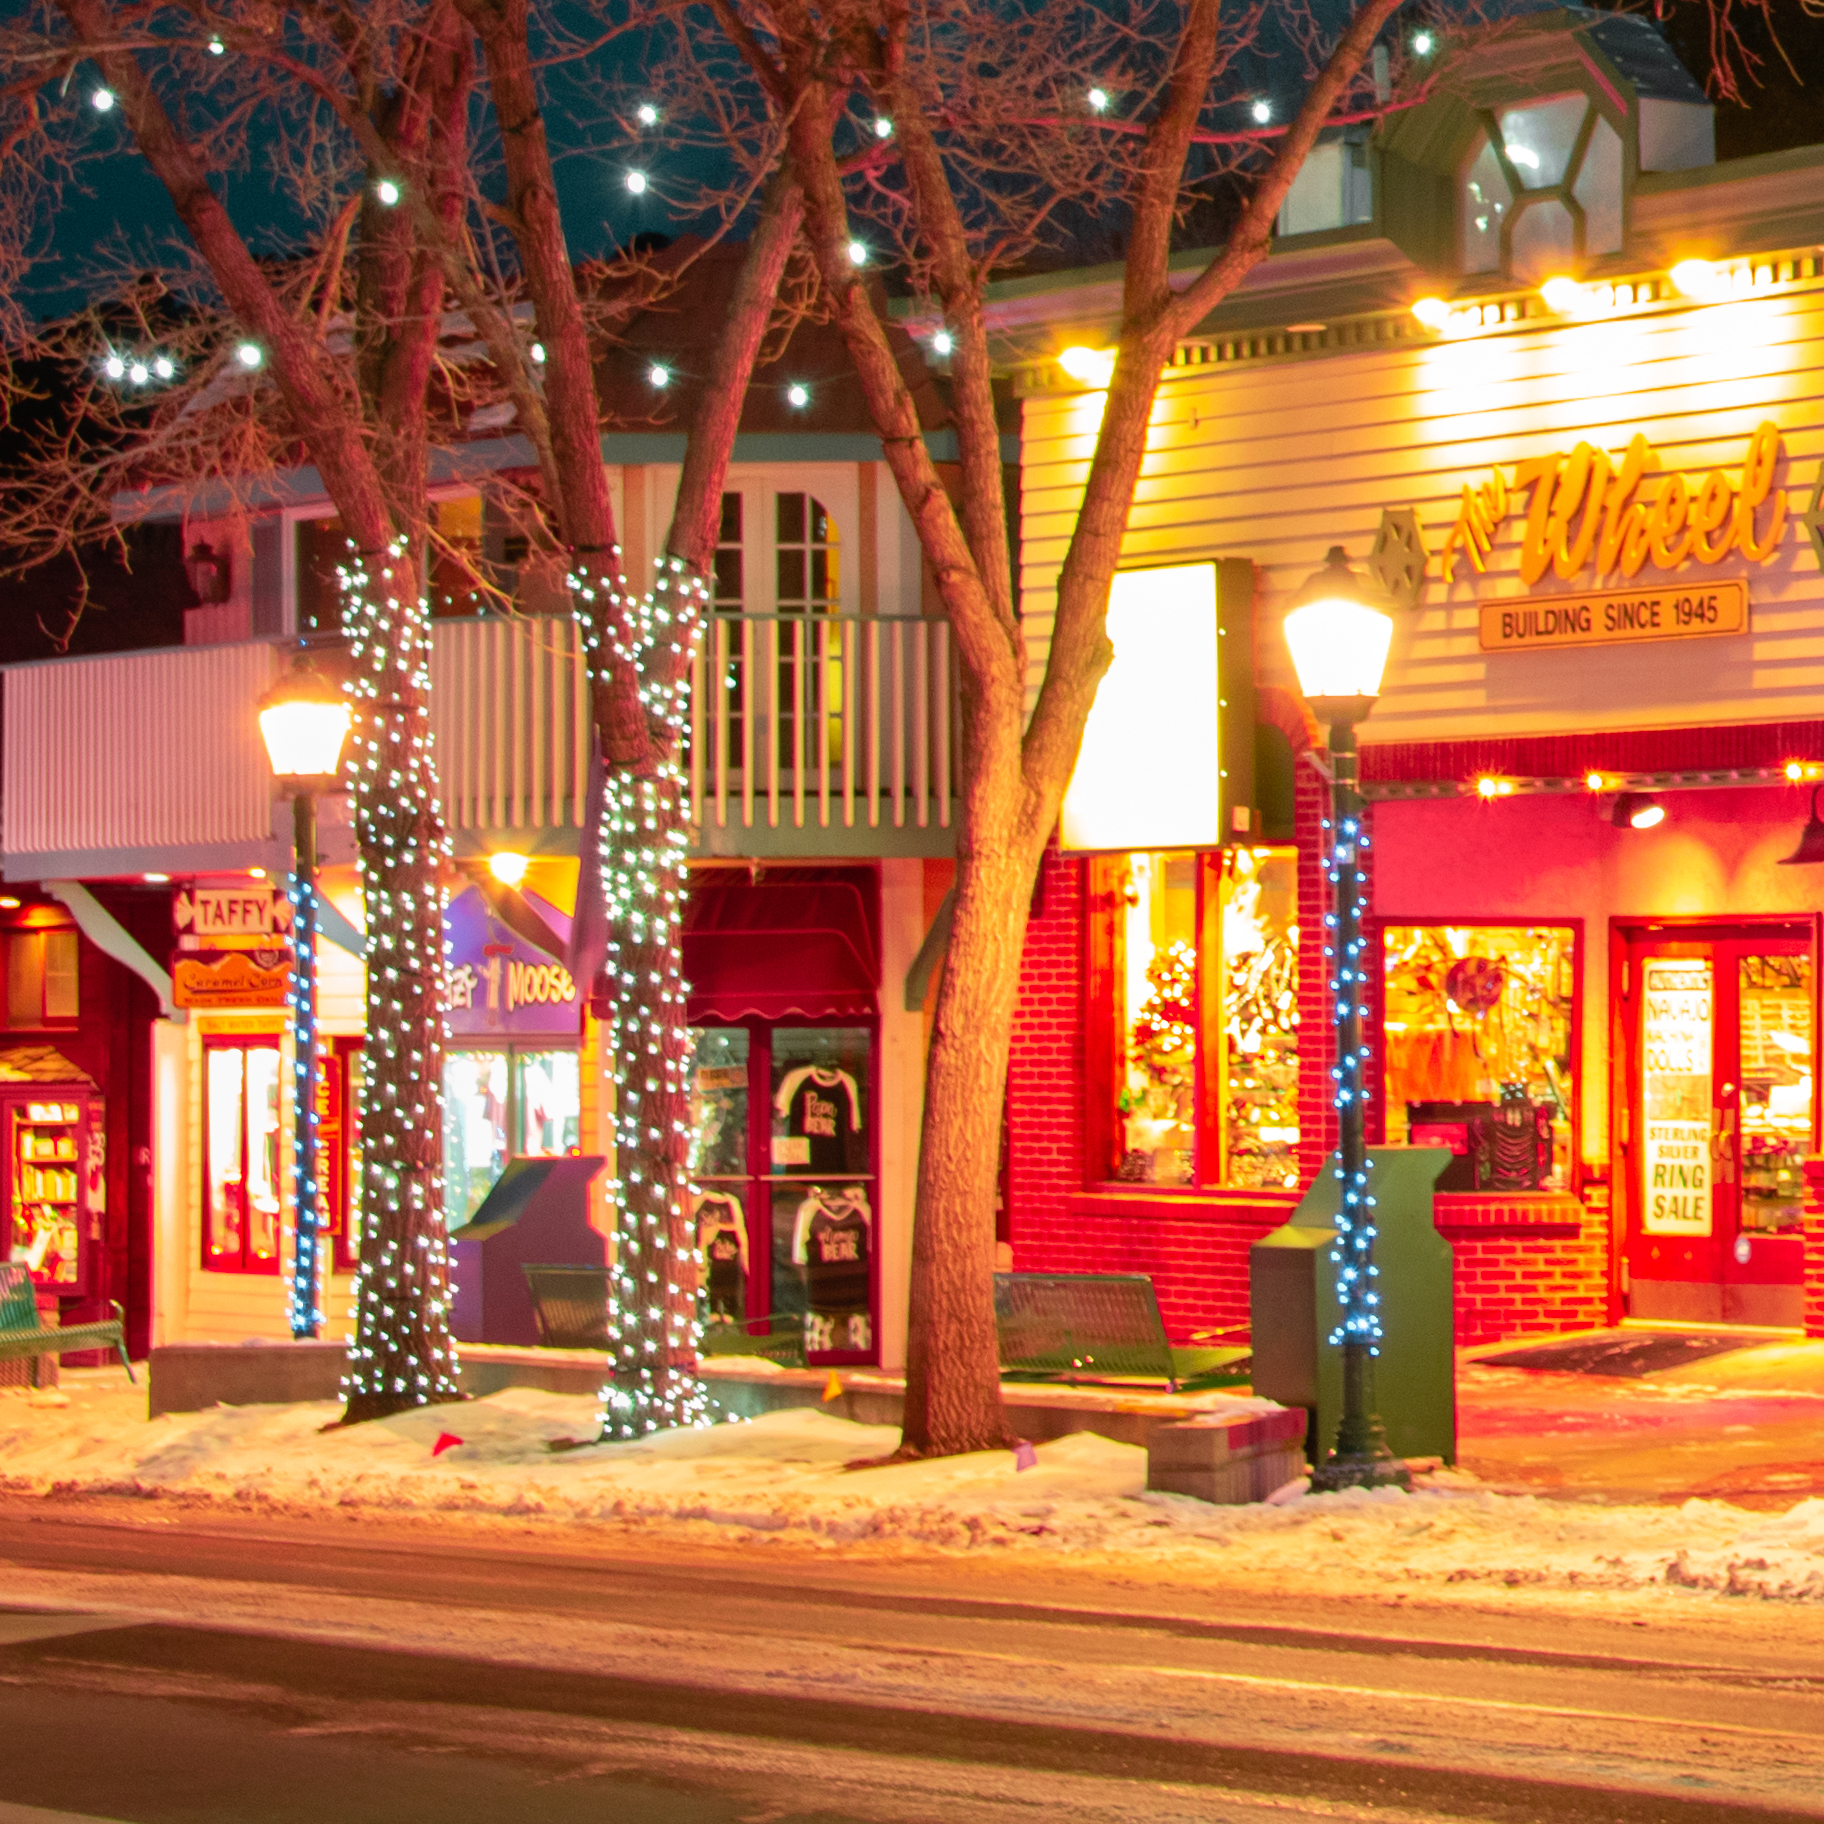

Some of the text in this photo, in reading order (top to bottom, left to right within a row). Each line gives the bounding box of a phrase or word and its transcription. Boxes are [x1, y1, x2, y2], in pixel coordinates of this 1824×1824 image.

[1513, 419, 1788, 587] Wheel
[1501, 594, 1719, 640] BUILDING SINCE 1945
[200, 899, 268, 926] TAFFY
[506, 960, 576, 1012] MOOSE
[1650, 1127, 1709, 1142] STERLING
[1658, 1146, 1700, 1160] SILVER
[1653, 1164, 1706, 1190] RING
[1653, 1194, 1707, 1222] SALE
